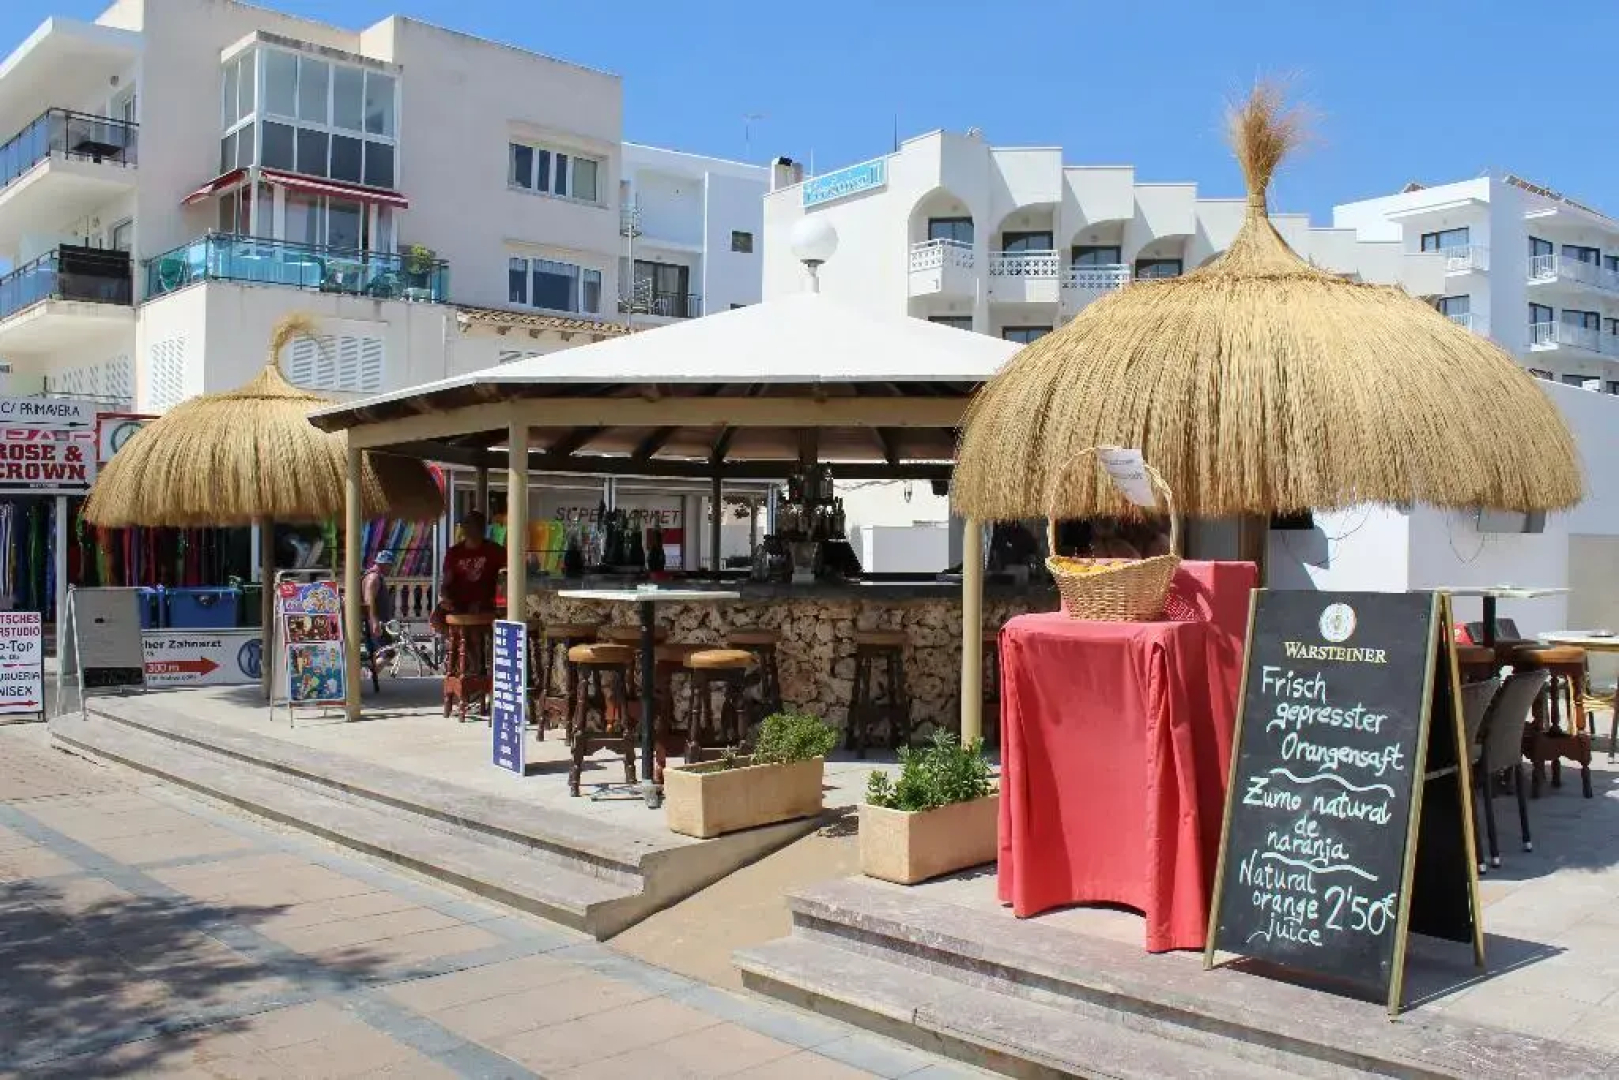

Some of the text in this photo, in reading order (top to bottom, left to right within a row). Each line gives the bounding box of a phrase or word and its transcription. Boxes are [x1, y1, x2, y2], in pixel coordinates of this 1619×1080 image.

[20, 403, 80, 417] PRIMAVERA
[65, 445, 83, 462] &
[168, 640, 222, 649] Zahnarzt
[1284, 641, 1387, 663] WARSTEINER
[1262, 665, 1326, 704] Frisch
[1266, 702, 1388, 734] gepresster
[1281, 732, 1404, 777] Orangensaft
[1243, 777, 1392, 825] Zumo natural
[1294, 815, 1320, 837] de
[1267, 831, 1349, 866] naranja
[1239, 849, 1317, 894] Natural
[1252, 889, 1319, 923] orange
[1246, 912, 1323, 946] juice
